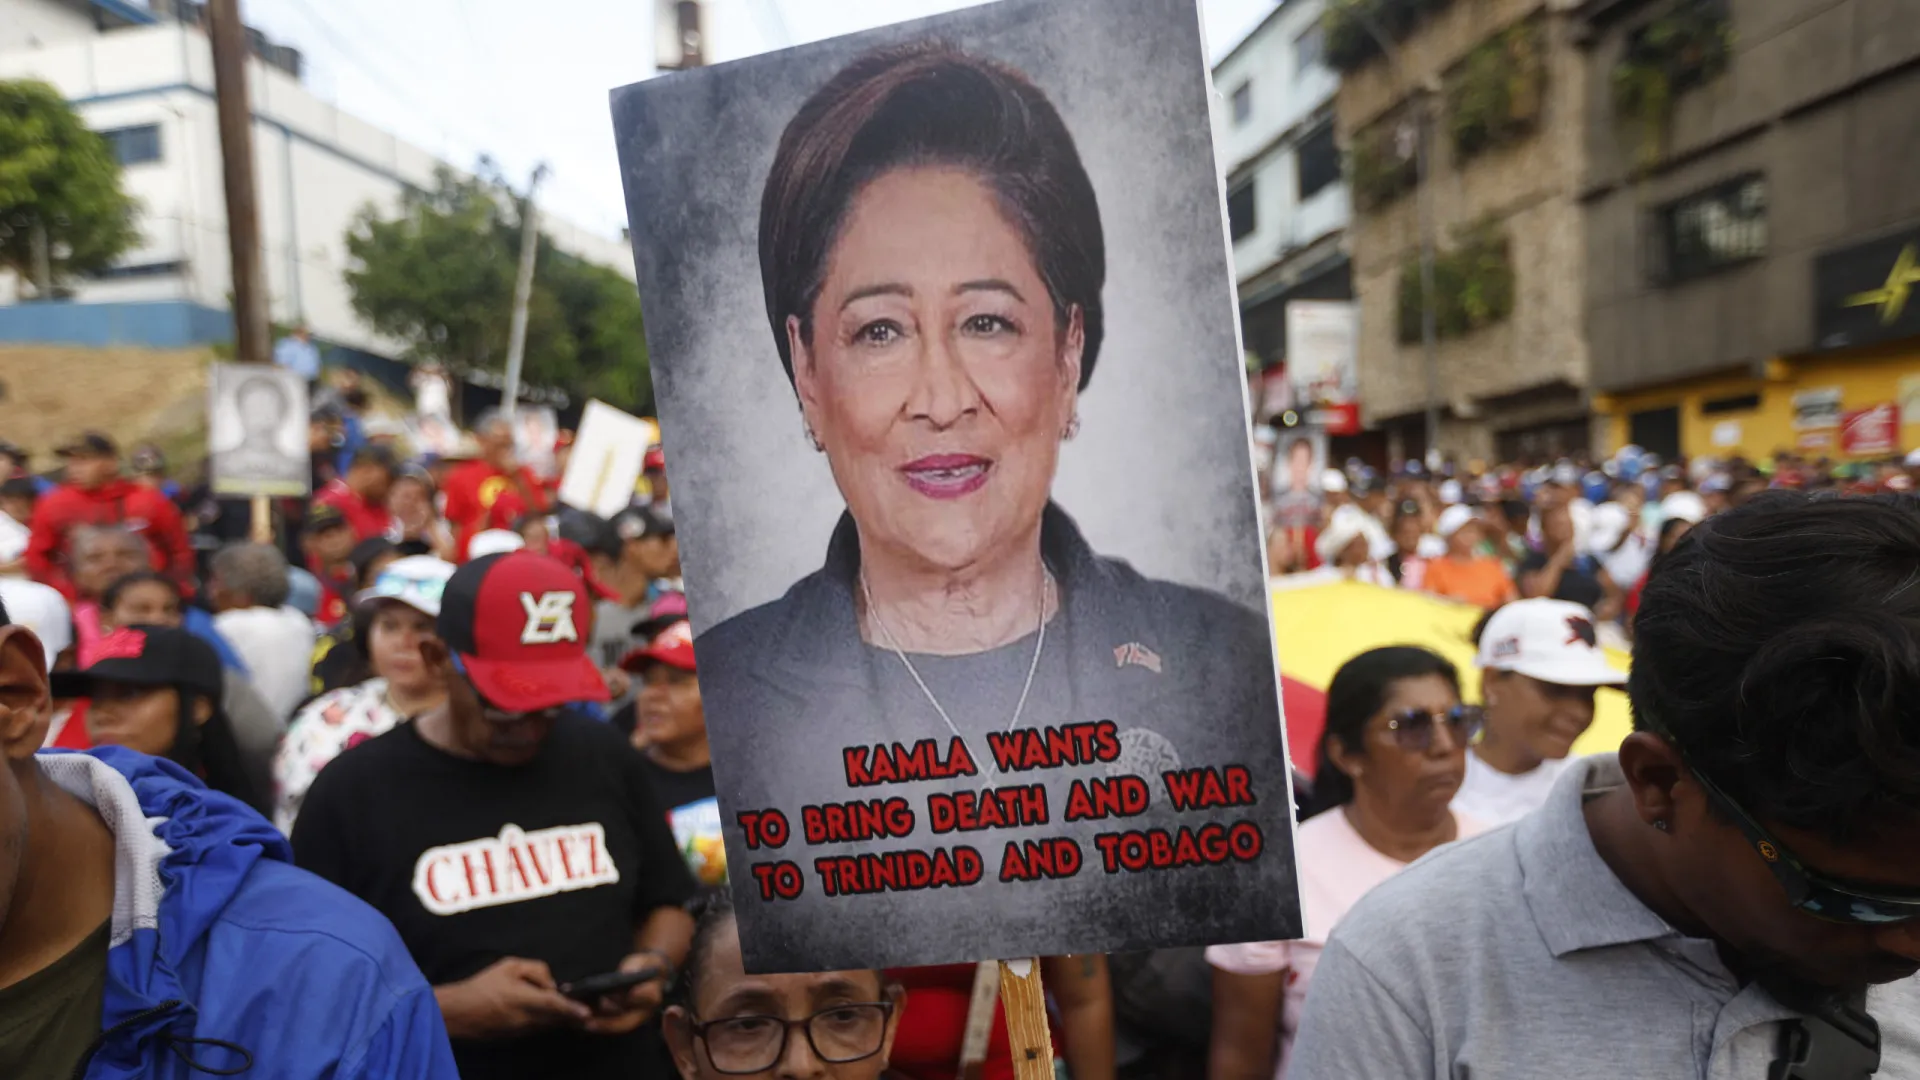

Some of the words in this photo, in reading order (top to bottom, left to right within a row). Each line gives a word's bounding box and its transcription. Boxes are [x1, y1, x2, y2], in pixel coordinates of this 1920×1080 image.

[843, 740, 977, 788] KAMLA
[987, 720, 1122, 771] WANTS
[737, 808, 790, 849] TO
[801, 796, 915, 845] BRING
[927, 784, 1049, 834] DEATH
[1065, 774, 1150, 821] AND
[1163, 764, 1254, 811] WAR
[424, 827, 608, 905] CHÁVEZ
[752, 860, 804, 900] TO
[814, 842, 984, 896] TRINIDAD
[999, 832, 1083, 882] AND
[1095, 820, 1263, 873] TOBAGO
